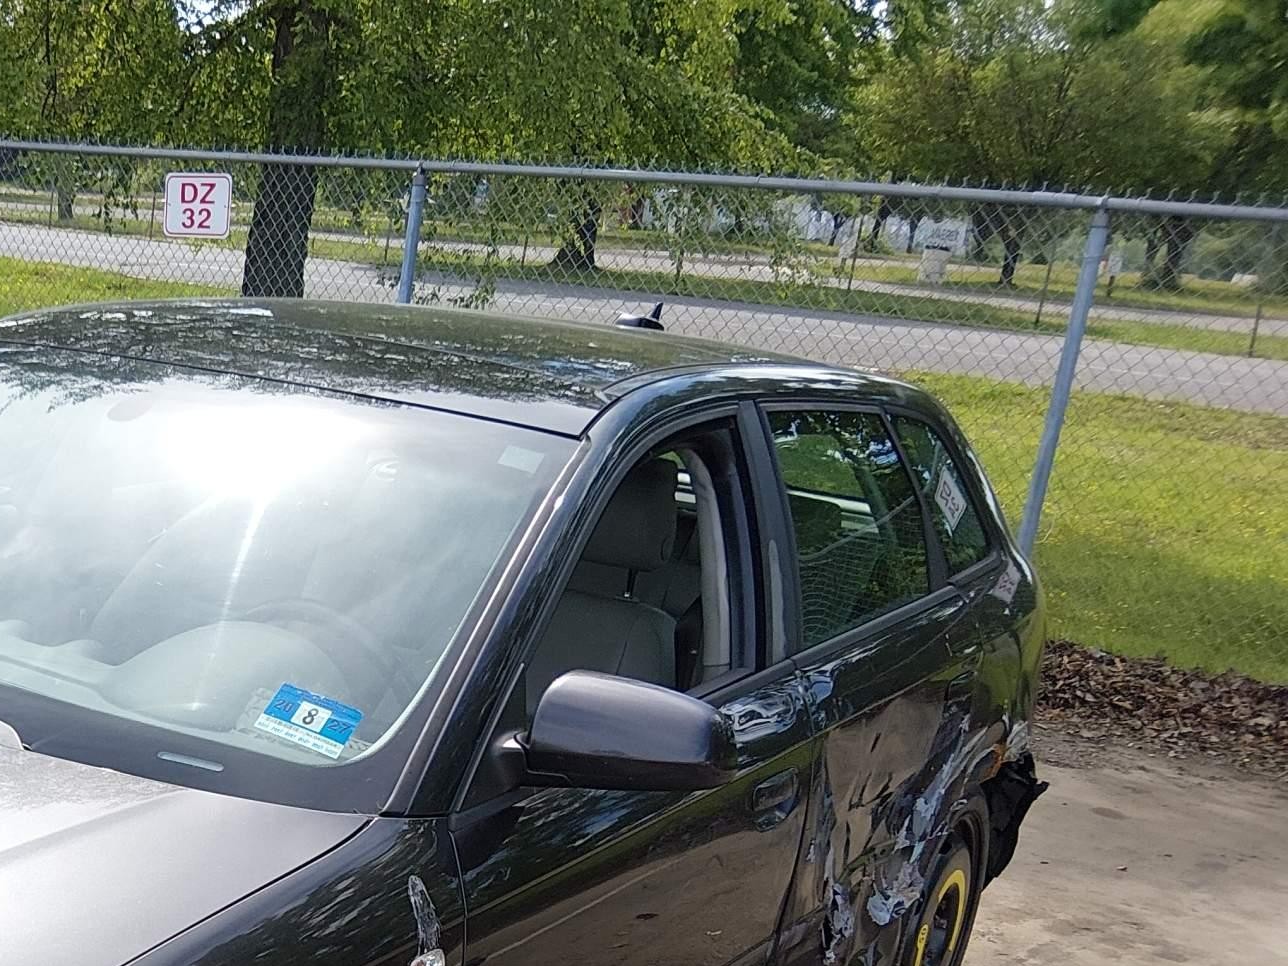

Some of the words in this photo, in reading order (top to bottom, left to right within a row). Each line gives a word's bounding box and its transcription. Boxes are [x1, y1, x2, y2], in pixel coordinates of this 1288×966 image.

[181, 182, 216, 204] DZ
[181, 208, 212, 229] 32
[302, 708, 319, 725] 8
[328, 720, 352, 734] 27
